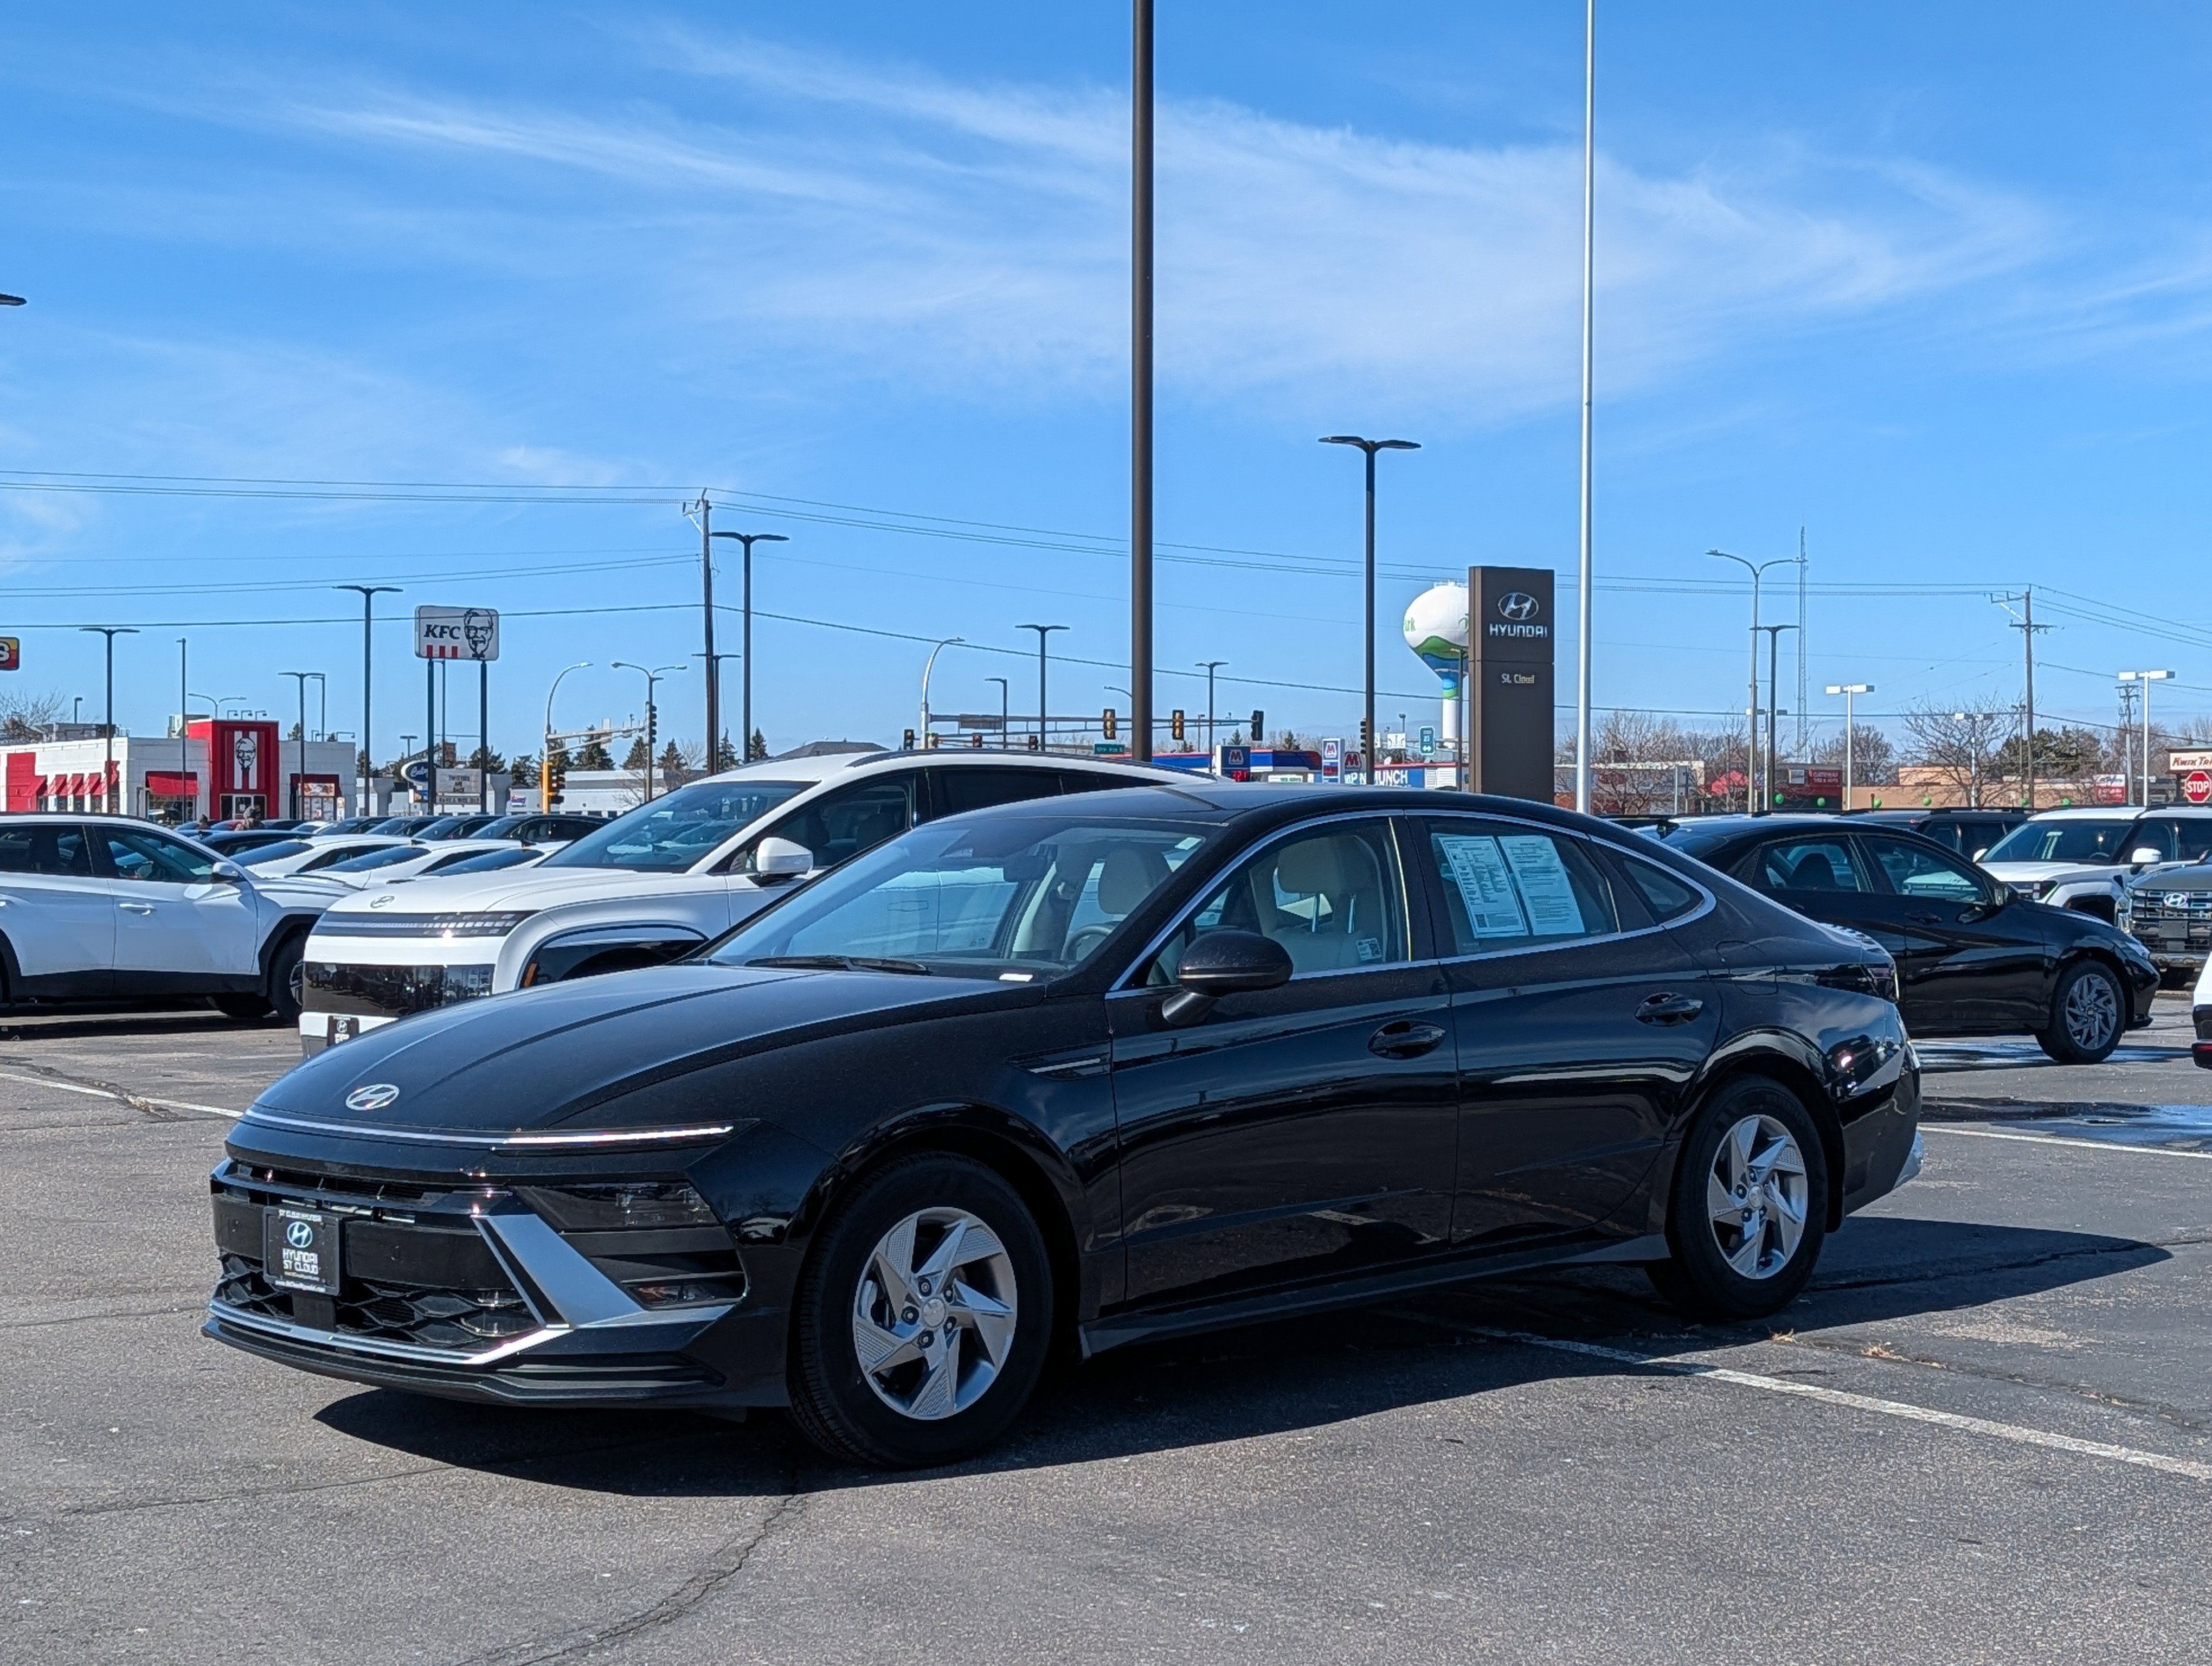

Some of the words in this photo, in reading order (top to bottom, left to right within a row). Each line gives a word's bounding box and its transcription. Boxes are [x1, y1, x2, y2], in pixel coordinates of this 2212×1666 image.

[423, 624, 461, 640] KFC
[1489, 624, 1547, 638] HYUNDAI
[1514, 674, 1535, 684] Cloud
[2187, 781, 2209, 793] STOP
[282, 1248, 319, 1264] HYUNDAI
[283, 1259, 293, 1270] ST
[294, 1261, 319, 1275] CLOUD
